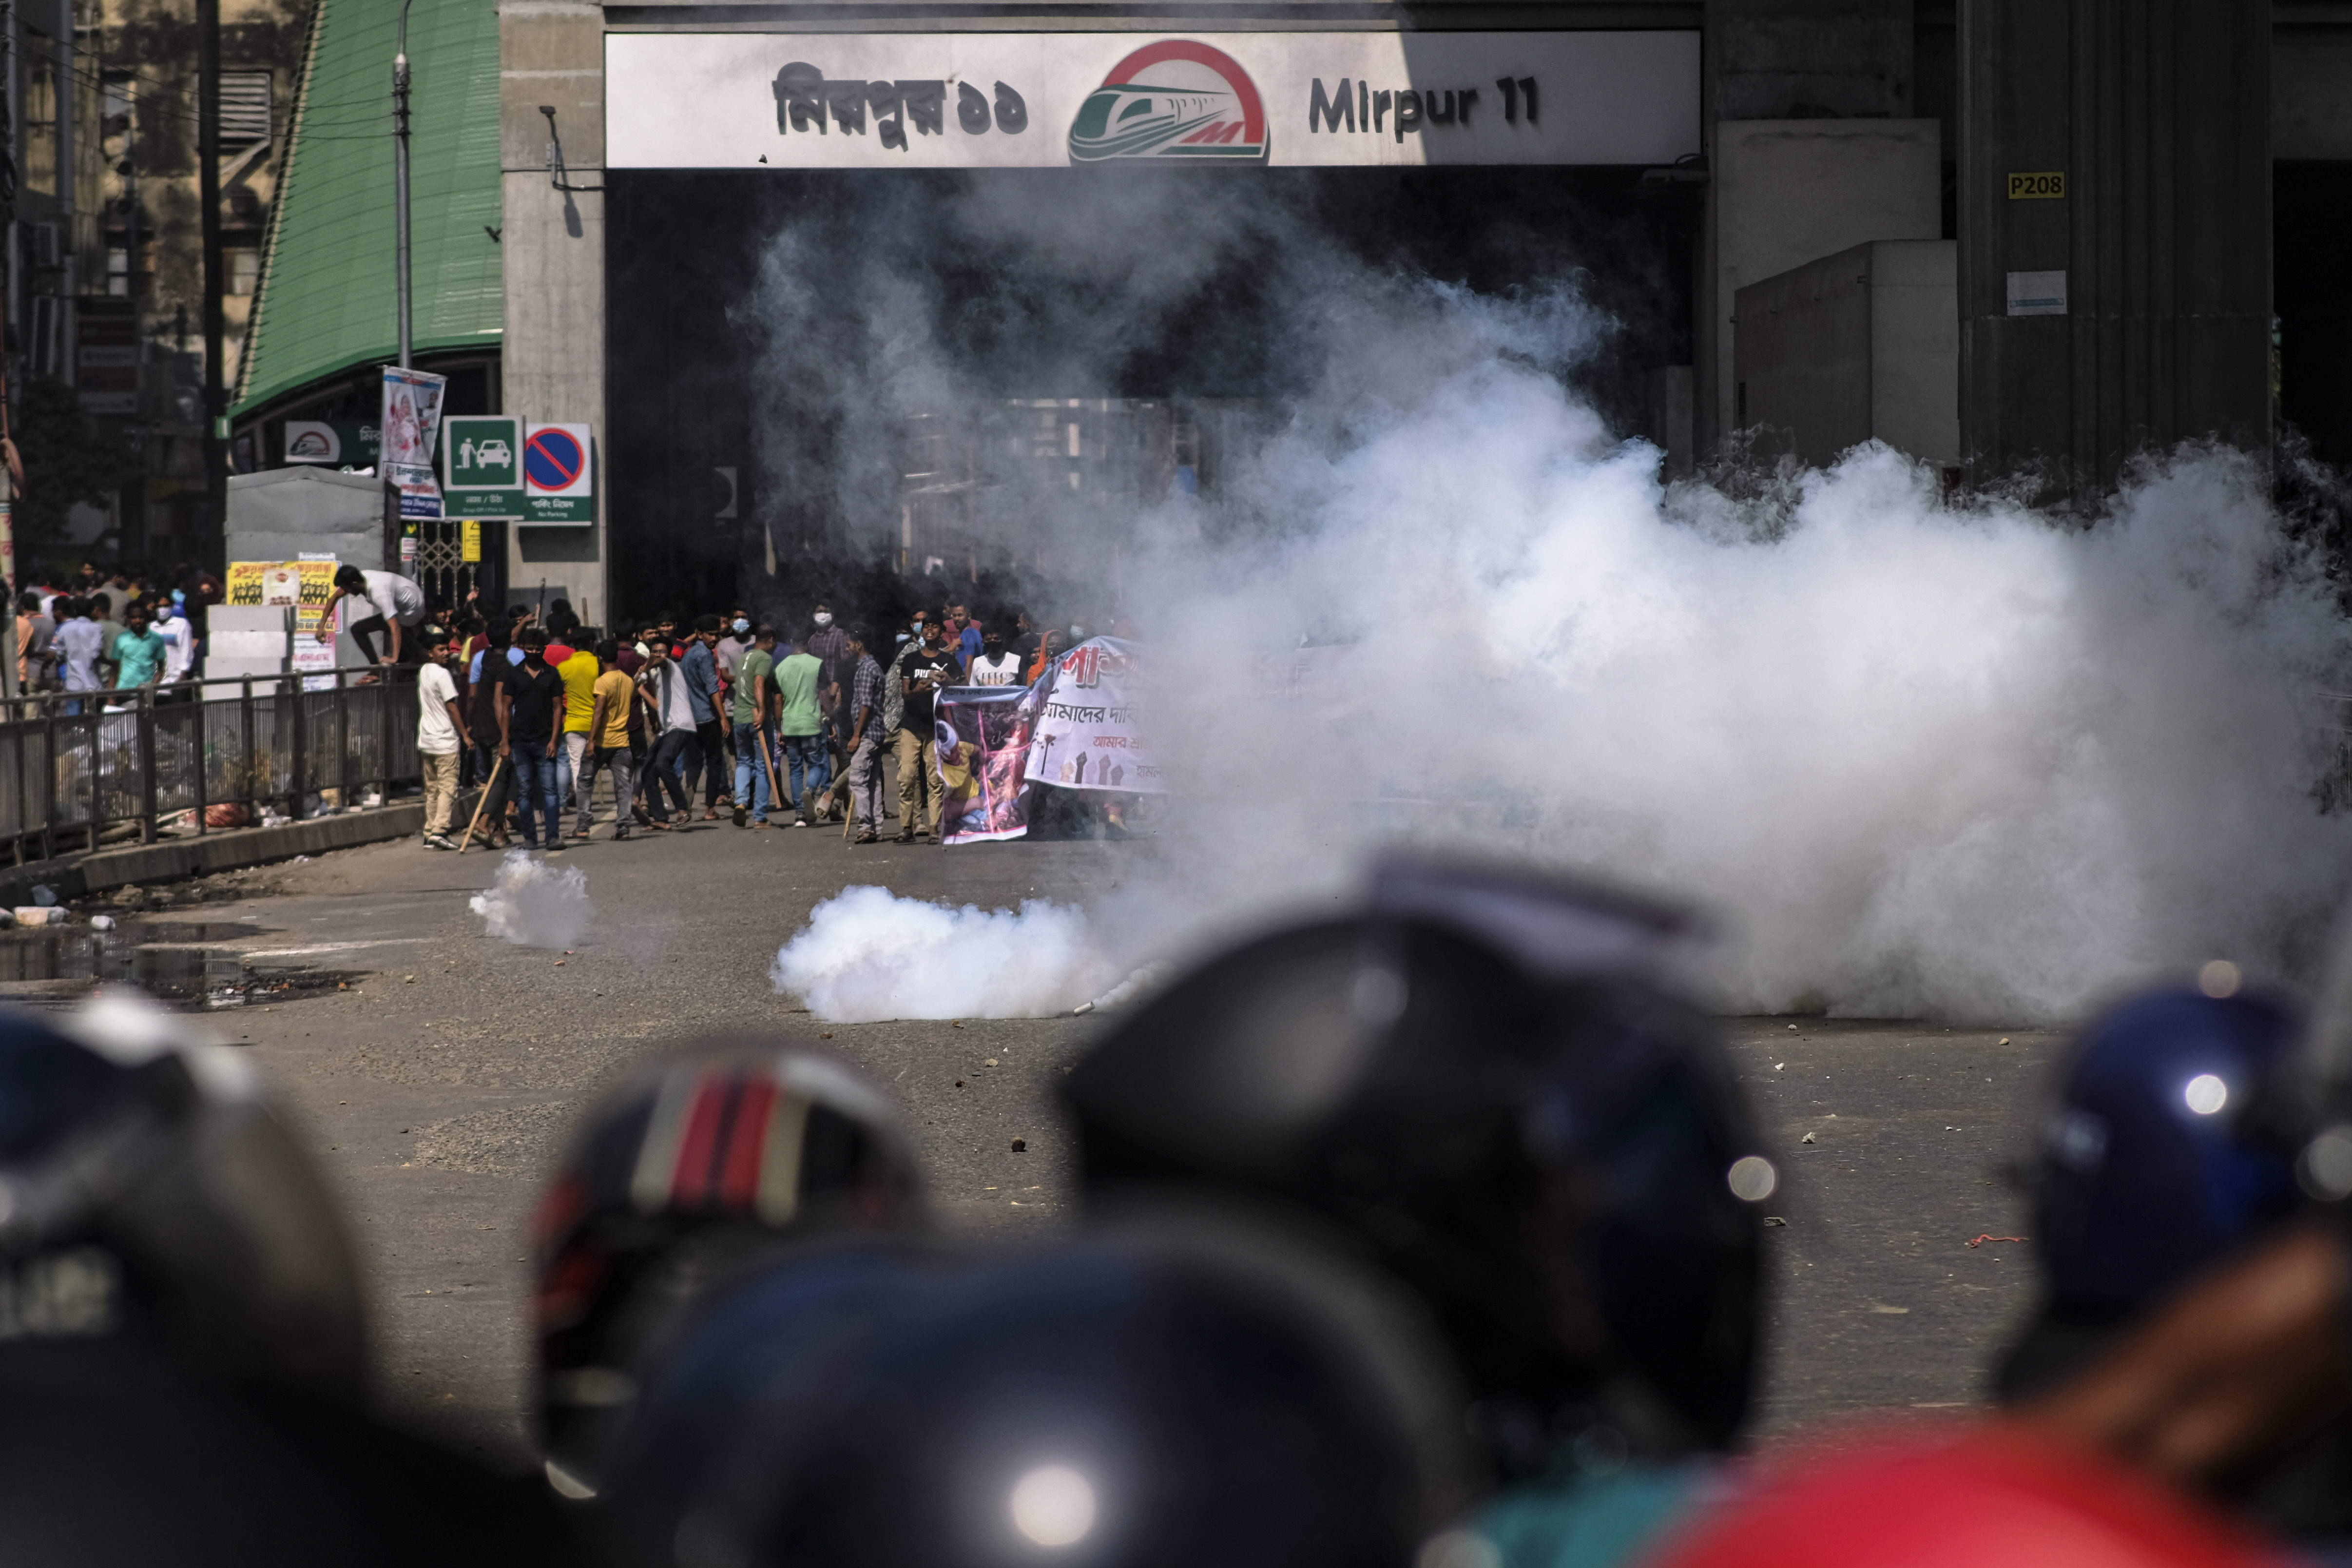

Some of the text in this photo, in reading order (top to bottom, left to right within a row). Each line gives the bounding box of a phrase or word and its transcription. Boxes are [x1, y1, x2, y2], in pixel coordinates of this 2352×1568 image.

[772, 61, 1028, 153] মিরপুর ১১
[1310, 76, 1538, 144] Mirpur 11
[2011, 175, 2063, 194] P208
[1093, 736, 1127, 749] আমার
